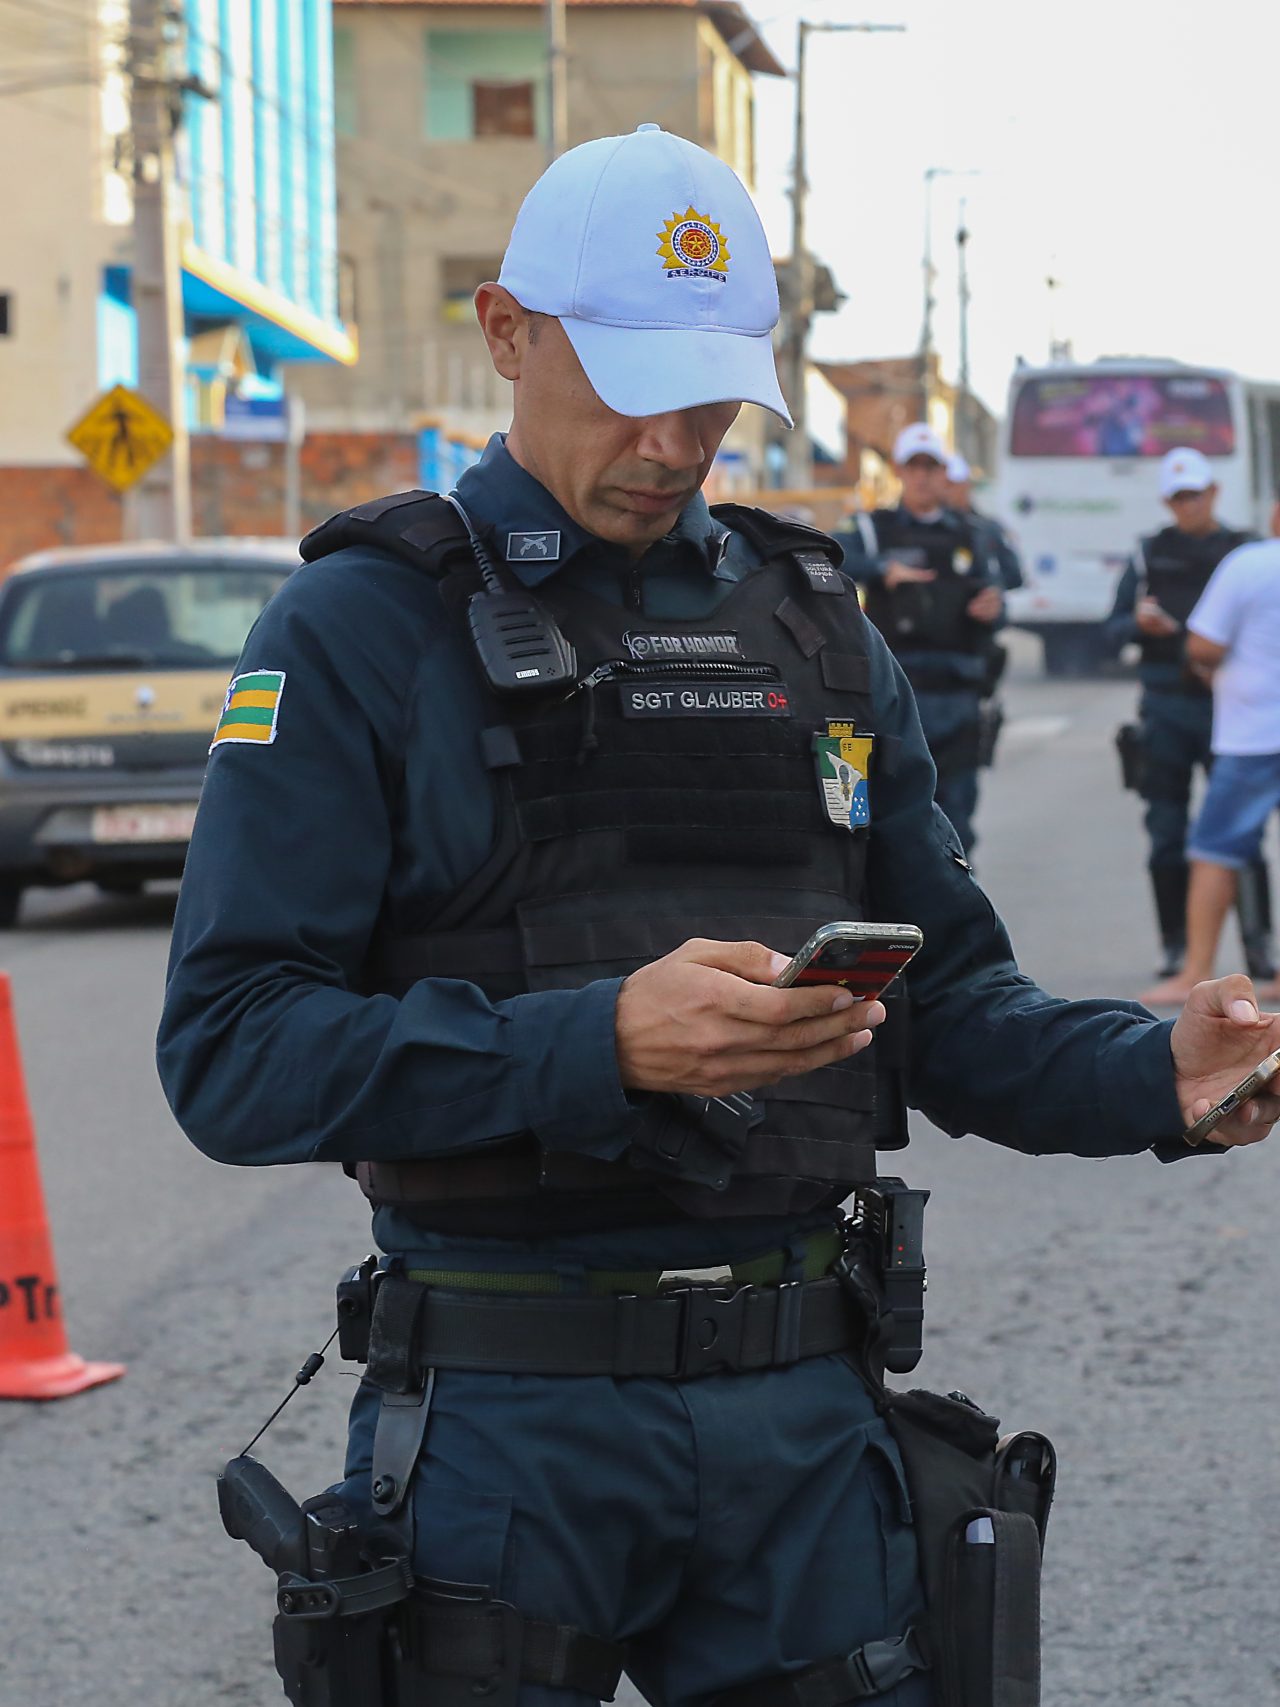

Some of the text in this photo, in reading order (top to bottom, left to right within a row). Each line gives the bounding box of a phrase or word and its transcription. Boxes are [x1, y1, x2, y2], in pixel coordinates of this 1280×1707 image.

[649, 636, 739, 654] FOR HONOR
[631, 692, 674, 709] SGT
[680, 691, 765, 708] GLAUBER
